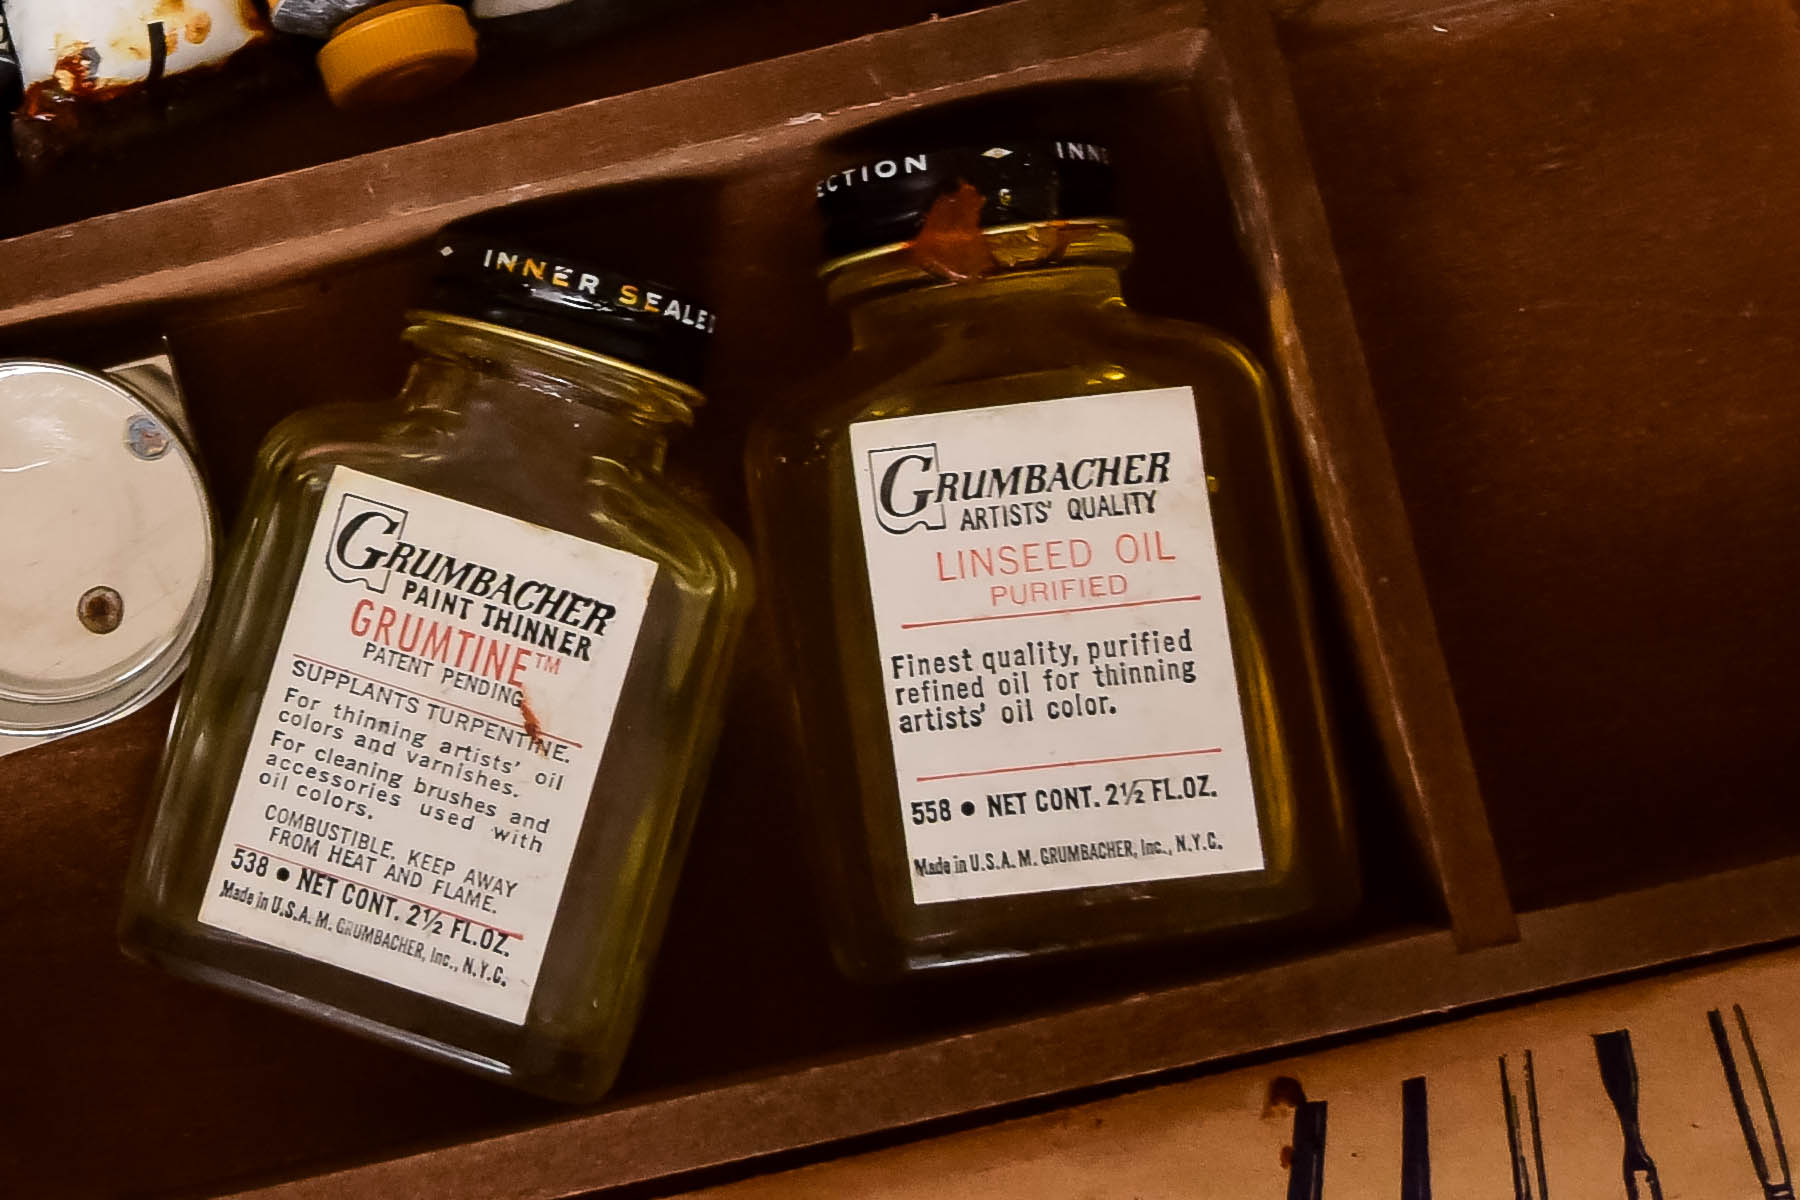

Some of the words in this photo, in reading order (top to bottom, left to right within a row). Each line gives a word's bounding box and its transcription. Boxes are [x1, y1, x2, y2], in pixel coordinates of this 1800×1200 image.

[484, 250, 599, 294] INNER
[619, 285, 712, 332] SEALE
[880, 452, 1170, 517] GRUMBACHER
[960, 501, 1051, 531] ARTISTS'
[1068, 490, 1156, 520] QUALITY
[337, 512, 616, 636] GRUMBACHER
[937, 540, 1091, 581] LINSEED
[1116, 531, 1176, 563] OIL
[991, 575, 1127, 606] PURIFIED
[402, 580, 474, 619] PAINT
[482, 604, 591, 661] THINNER
[891, 649, 973, 679] Finest
[983, 641, 1078, 674] quality,
[1087, 629, 1192, 664] purified
[292, 660, 419, 713] SUPPLANTS
[428, 704, 569, 763] TURPENTINE.
[363, 642, 434, 677] PATENT
[441, 668, 526, 711] PENDING
[896, 676, 984, 705] refined
[999, 671, 1029, 695] oil
[1043, 669, 1079, 691] for
[1092, 659, 1196, 687] thinning
[900, 703, 985, 733] artists'
[1002, 699, 1033, 723] oil
[1047, 694, 1116, 719] color.
[275, 705, 348, 743] colors
[351, 729, 398, 759] and
[408, 751, 518, 797] varnishes.
[285, 688, 320, 710] For
[334, 704, 427, 748] thinning
[440, 742, 520, 773] artists'
[532, 766, 565, 793] oil
[256, 768, 290, 793] oil
[297, 785, 372, 819] colors.
[266, 754, 401, 806] accessories
[420, 804, 475, 830] used
[489, 821, 546, 856] with
[271, 730, 305, 753] For
[315, 748, 403, 788] cleaning
[414, 777, 496, 816] brushes
[506, 806, 551, 835] and
[911, 799, 951, 825] 558
[987, 792, 1026, 817] NET
[1036, 786, 1100, 812] CONT.
[1148, 775, 1217, 801] FL.OZ.
[265, 805, 395, 860] COMBUSTIBLE.
[404, 847, 458, 882] KEEP
[464, 869, 518, 897] AWAY
[269, 827, 320, 857] FROM
[328, 845, 377, 873] HEAT
[384, 864, 422, 887] AND
[432, 880, 496, 913] FLAME.
[914, 857, 951, 877] Made
[953, 855, 967, 873] in
[1018, 850, 1037, 867] M.
[1176, 832, 1223, 852] N.Y.C.
[219, 880, 254, 905] Made
[253, 889, 272, 912] in
[314, 909, 336, 934] M.
[463, 957, 506, 987] N.Y.C.
[231, 848, 268, 877] 538
[296, 868, 338, 898] NET
[343, 884, 398, 920] CONT.
[450, 916, 518, 957] FL.OZ.
